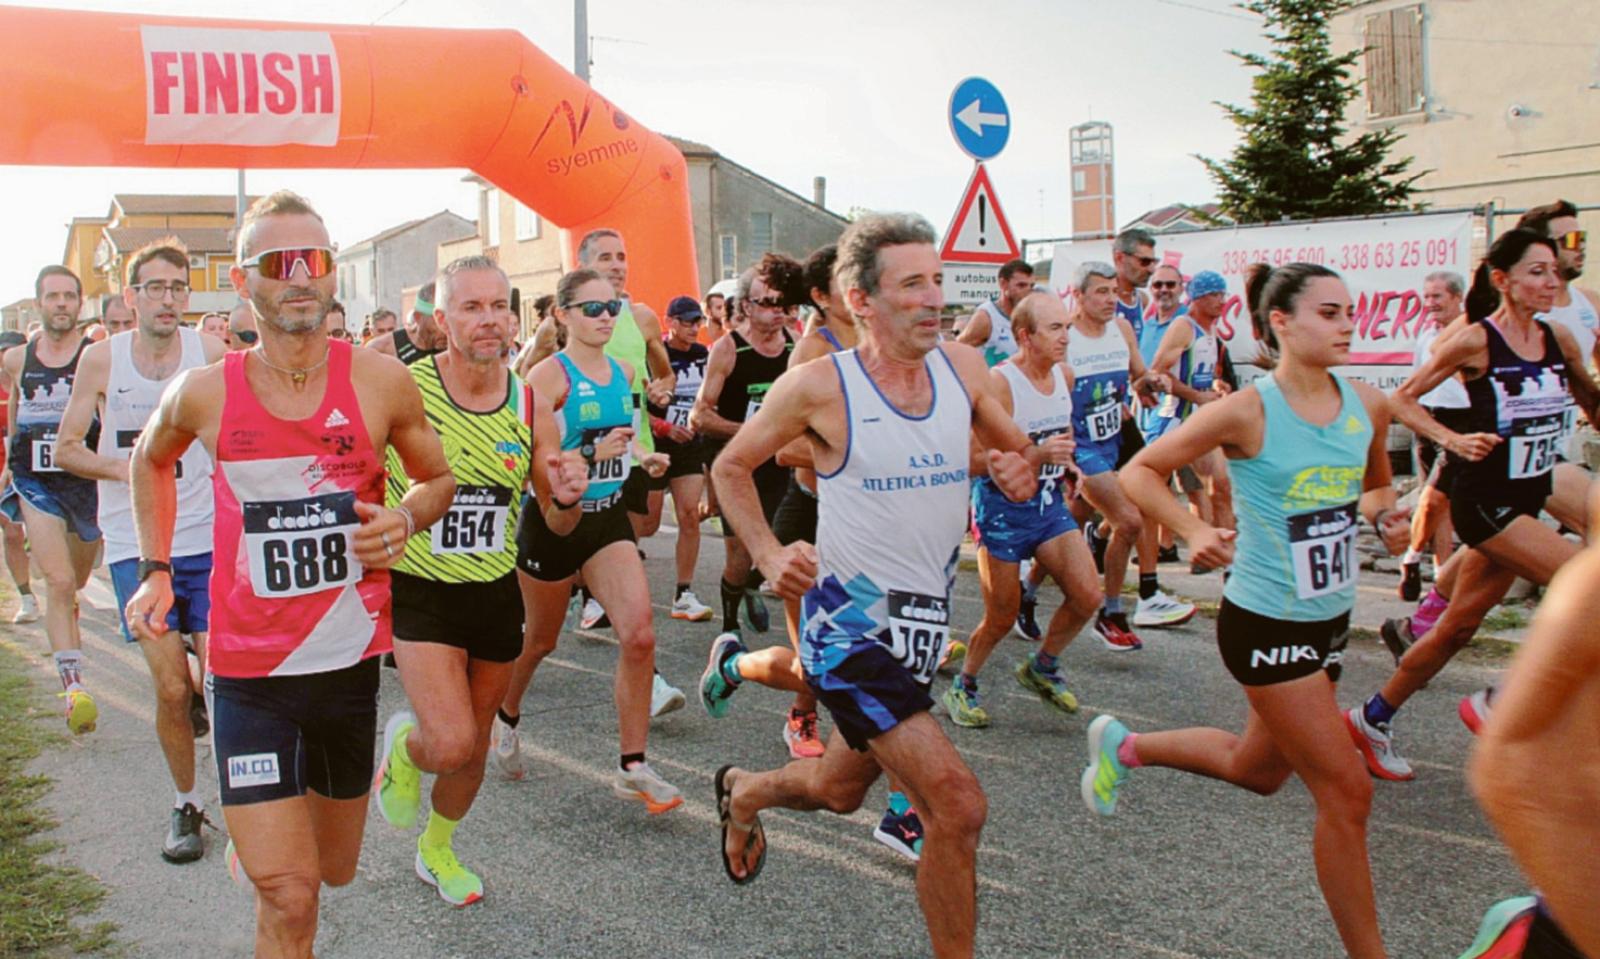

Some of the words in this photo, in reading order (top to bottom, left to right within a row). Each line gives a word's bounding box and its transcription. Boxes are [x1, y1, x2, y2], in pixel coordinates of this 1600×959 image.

[150, 52, 335, 115] FINISH
[546, 138, 639, 177] syemme
[1341, 244, 1369, 270] 338
[1375, 242, 1395, 268] 63
[1400, 240, 1421, 267] 25
[1427, 238, 1458, 265] 091
[955, 271, 996, 283] autobus
[909, 453, 949, 469] A.S.D.
[862, 476, 927, 492] ATLETICA
[267, 503, 338, 530] diadora
[442, 510, 497, 549] 654
[263, 533, 348, 592] 688
